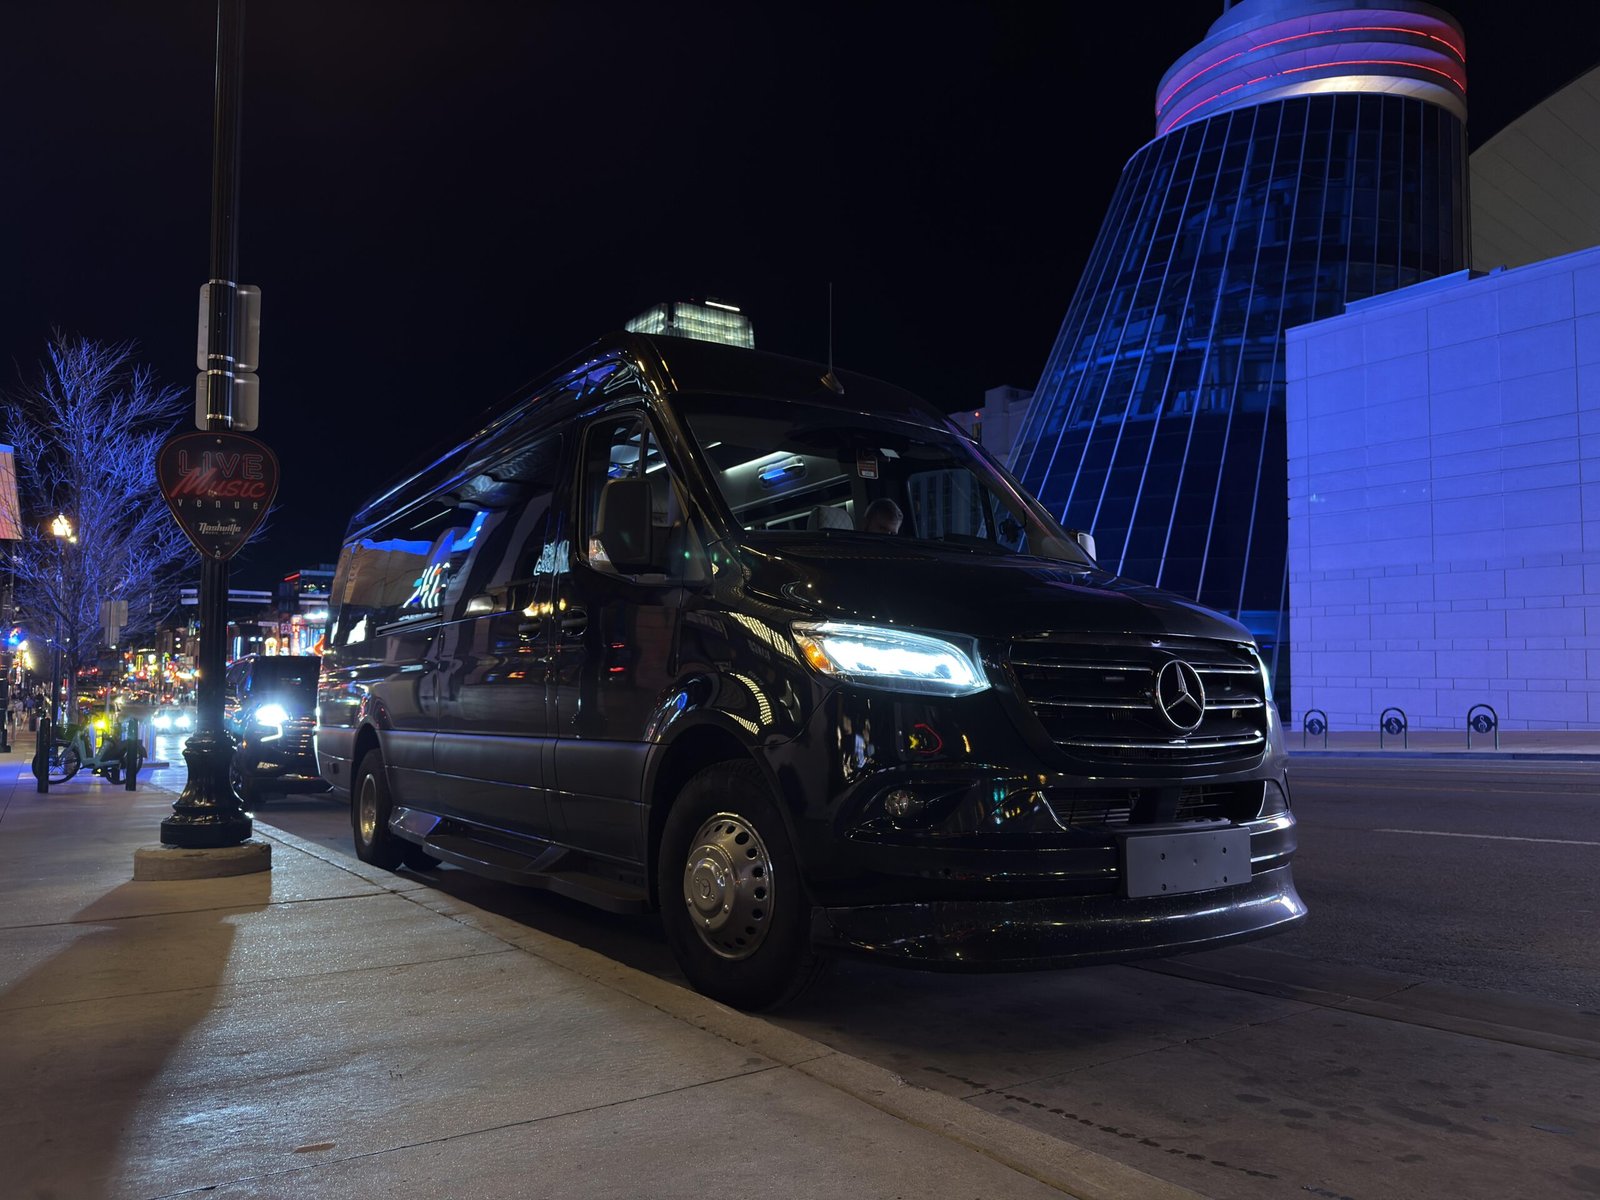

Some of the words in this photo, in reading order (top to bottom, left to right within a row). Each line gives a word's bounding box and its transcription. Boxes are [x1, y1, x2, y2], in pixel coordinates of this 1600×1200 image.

[178, 449, 264, 480] LIVE
[177, 498, 259, 510] venue
[198, 522, 242, 535] Nashville
